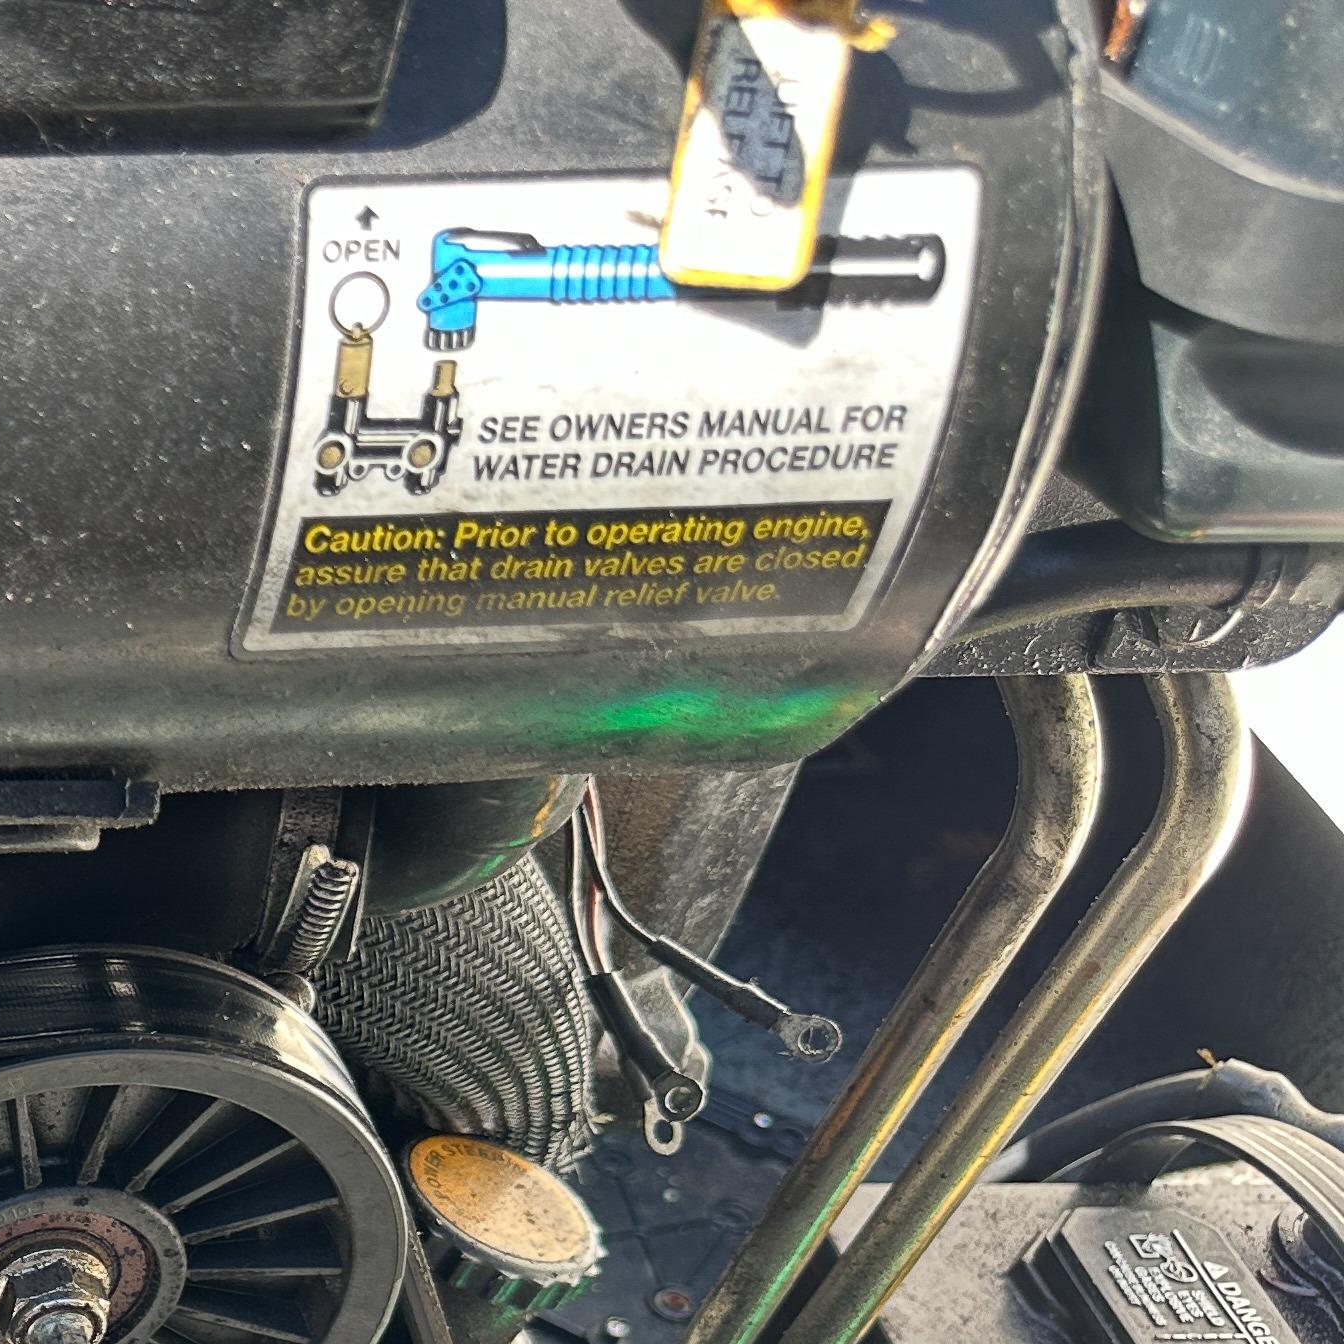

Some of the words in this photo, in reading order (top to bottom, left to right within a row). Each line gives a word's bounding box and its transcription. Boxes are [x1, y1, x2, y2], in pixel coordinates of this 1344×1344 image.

[762, 78, 802, 155] LIFT
[323, 238, 402, 265] OPEN
[477, 415, 541, 443] SEE
[548, 411, 690, 443] OWNERS
[697, 406, 831, 439] MANUAL
[840, 404, 909, 433] FOR
[472, 453, 583, 482] WATER
[590, 448, 690, 479] DRAIN
[697, 443, 899, 476] PROCEDURE
[304, 523, 445, 553] Caution:
[453, 520, 538, 549] Prior
[544, 520, 579, 548] to
[586, 515, 745, 550] operating
[752, 511, 872, 541] engine,
[295, 562, 407, 588] assure
[416, 555, 483, 583] that
[489, 553, 575, 581] drain
[583, 550, 685, 578] valves
[692, 552, 746, 576] are
[286, 592, 326, 622] by
[335, 590, 466, 620] opening
[475, 583, 599, 611] manual
[603, 580, 690, 608] relief
[695, 579, 782, 605] valve.
[424, 1149, 450, 1202] POWER
